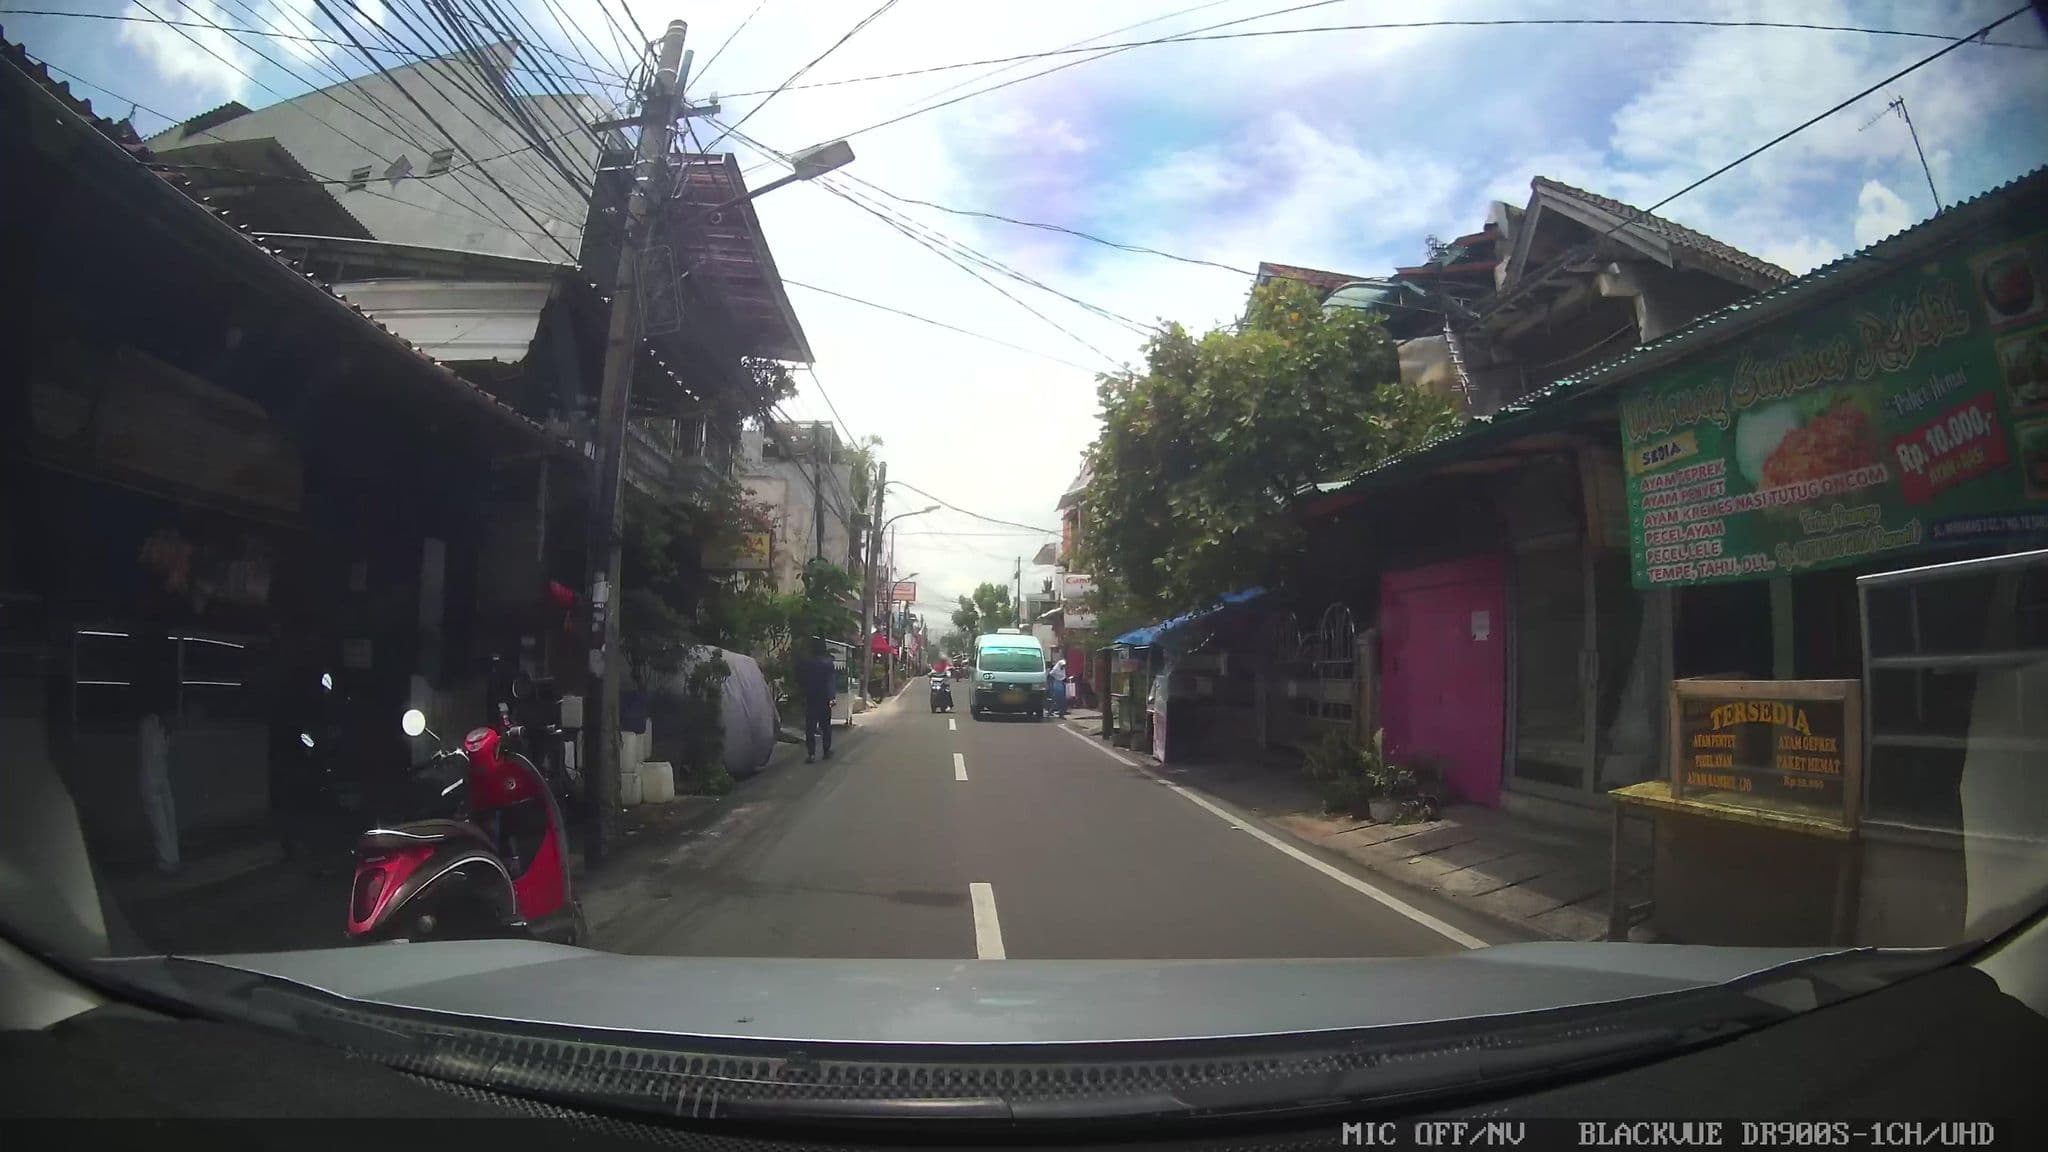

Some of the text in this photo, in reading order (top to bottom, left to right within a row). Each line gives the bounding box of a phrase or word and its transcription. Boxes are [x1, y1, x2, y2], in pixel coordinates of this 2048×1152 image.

[1729, 339, 1849, 408] Sumber
[1642, 441, 1682, 466] SEDIA
[1895, 443, 1928, 475] Rp.
[1641, 473, 1675, 491] AYAM
[1642, 491, 1678, 508] AYAM
[1644, 509, 1680, 527] AYAM
[1680, 498, 1733, 522] KREMES
[1735, 491, 1767, 511] NASI
[1645, 519, 1725, 546] PECEL AYAM
[1646, 540, 1722, 564] PECEL LELE
[1710, 701, 1813, 736] TERSEDIA
[1778, 735, 1801, 751] AYAM
